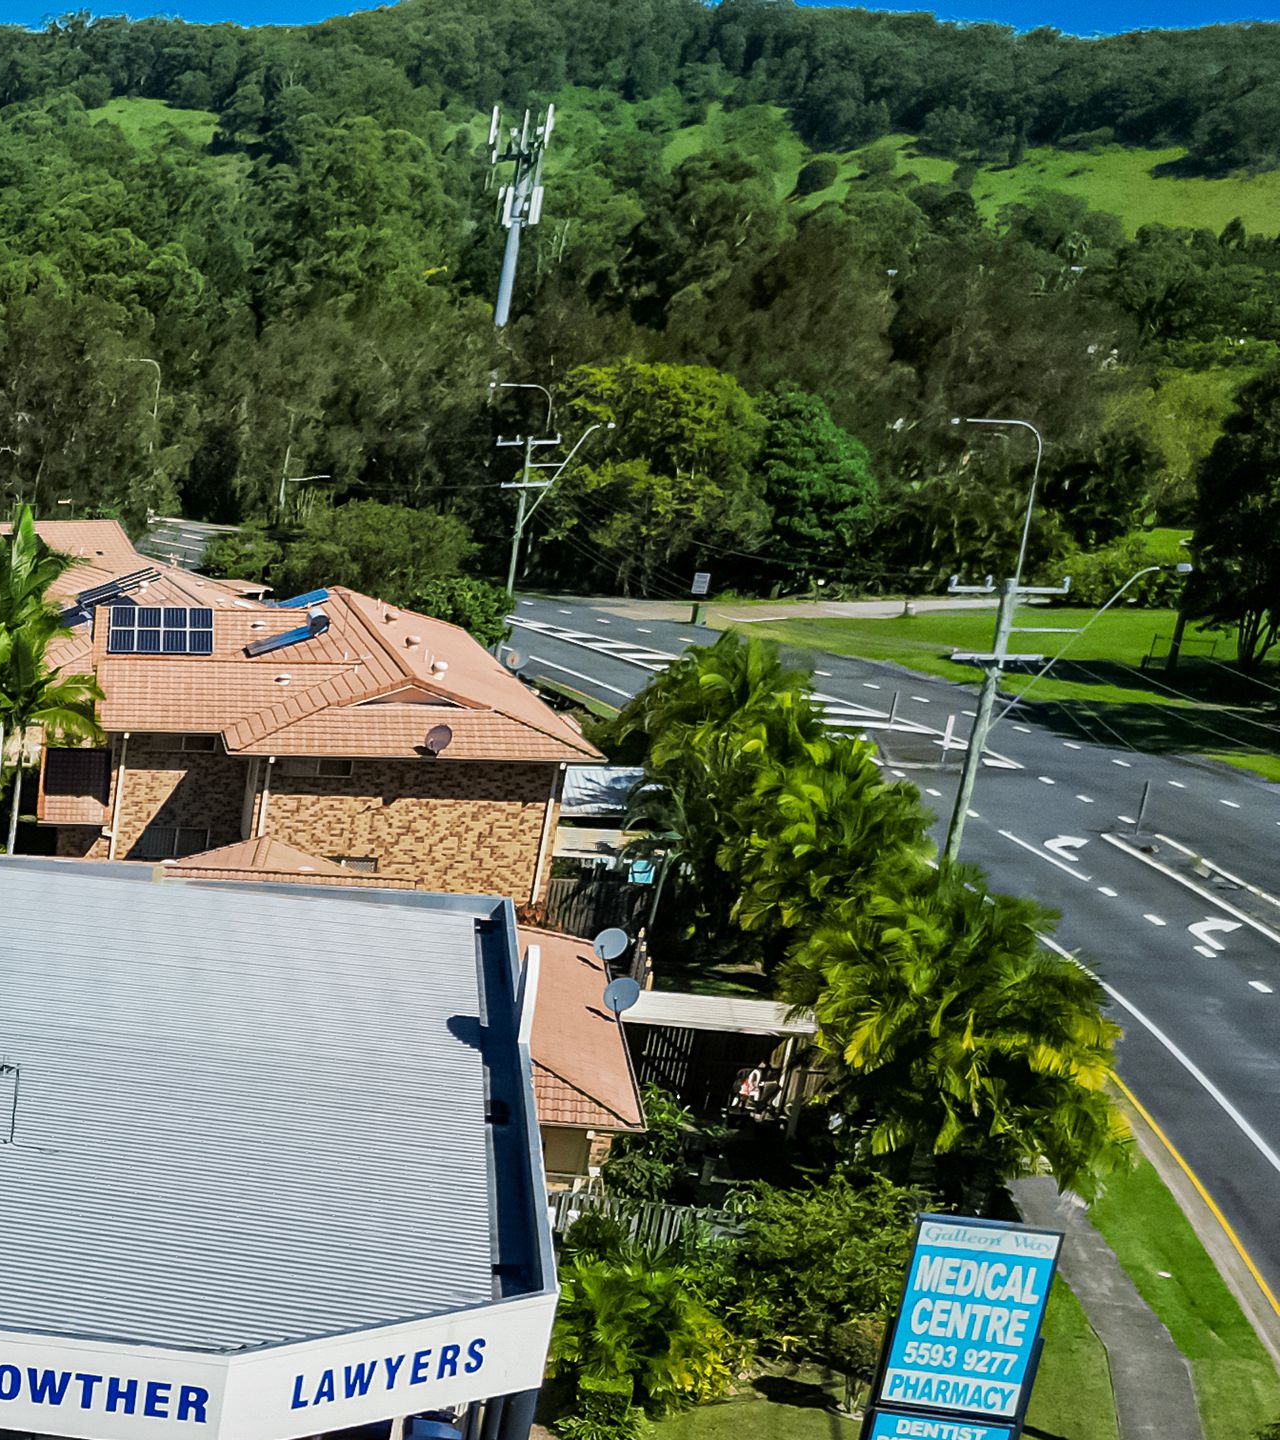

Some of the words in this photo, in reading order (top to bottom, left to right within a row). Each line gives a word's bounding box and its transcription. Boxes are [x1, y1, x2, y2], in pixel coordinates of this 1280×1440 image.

[925, 1226, 1001, 1247] Galleon
[1013, 1233, 1052, 1254] Way
[913, 1255, 1040, 1305] MEDICAL
[910, 1297, 1031, 1347] CENTRE
[290, 1337, 487, 1410] LAWYERS
[903, 1341, 958, 1368] 5593
[962, 1348, 1019, 1376] 9277
[888, 1373, 1016, 1412] PHARMACY
